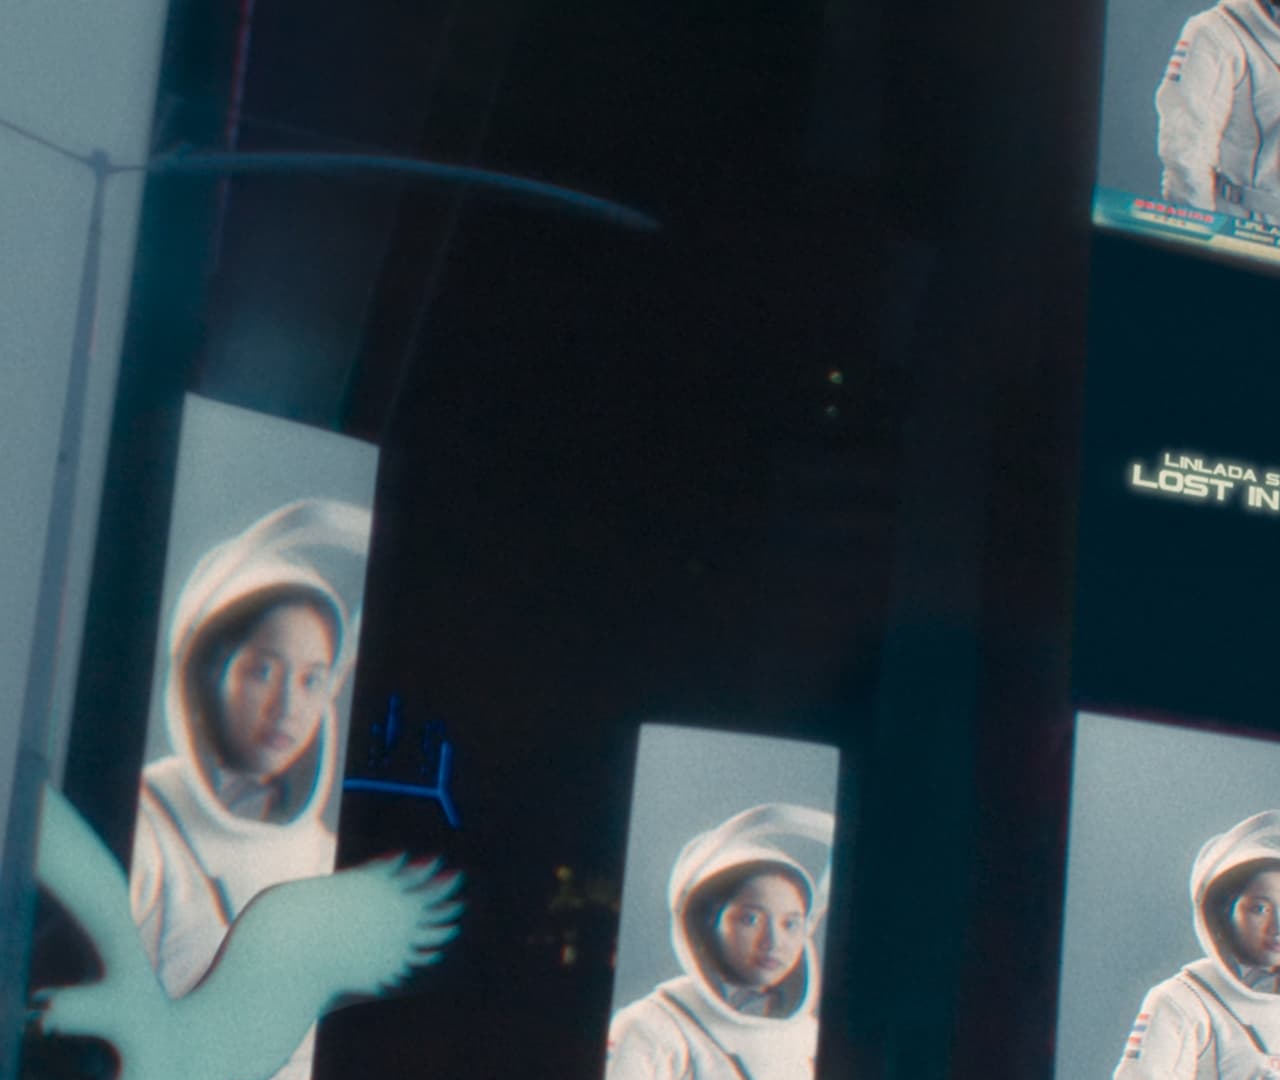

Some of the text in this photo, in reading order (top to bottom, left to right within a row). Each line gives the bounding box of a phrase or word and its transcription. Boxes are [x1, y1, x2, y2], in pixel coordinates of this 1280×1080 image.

[1164, 453, 1257, 483] LINLADA
[1132, 464, 1234, 501] LOST
[1248, 485, 1280, 511] IN
